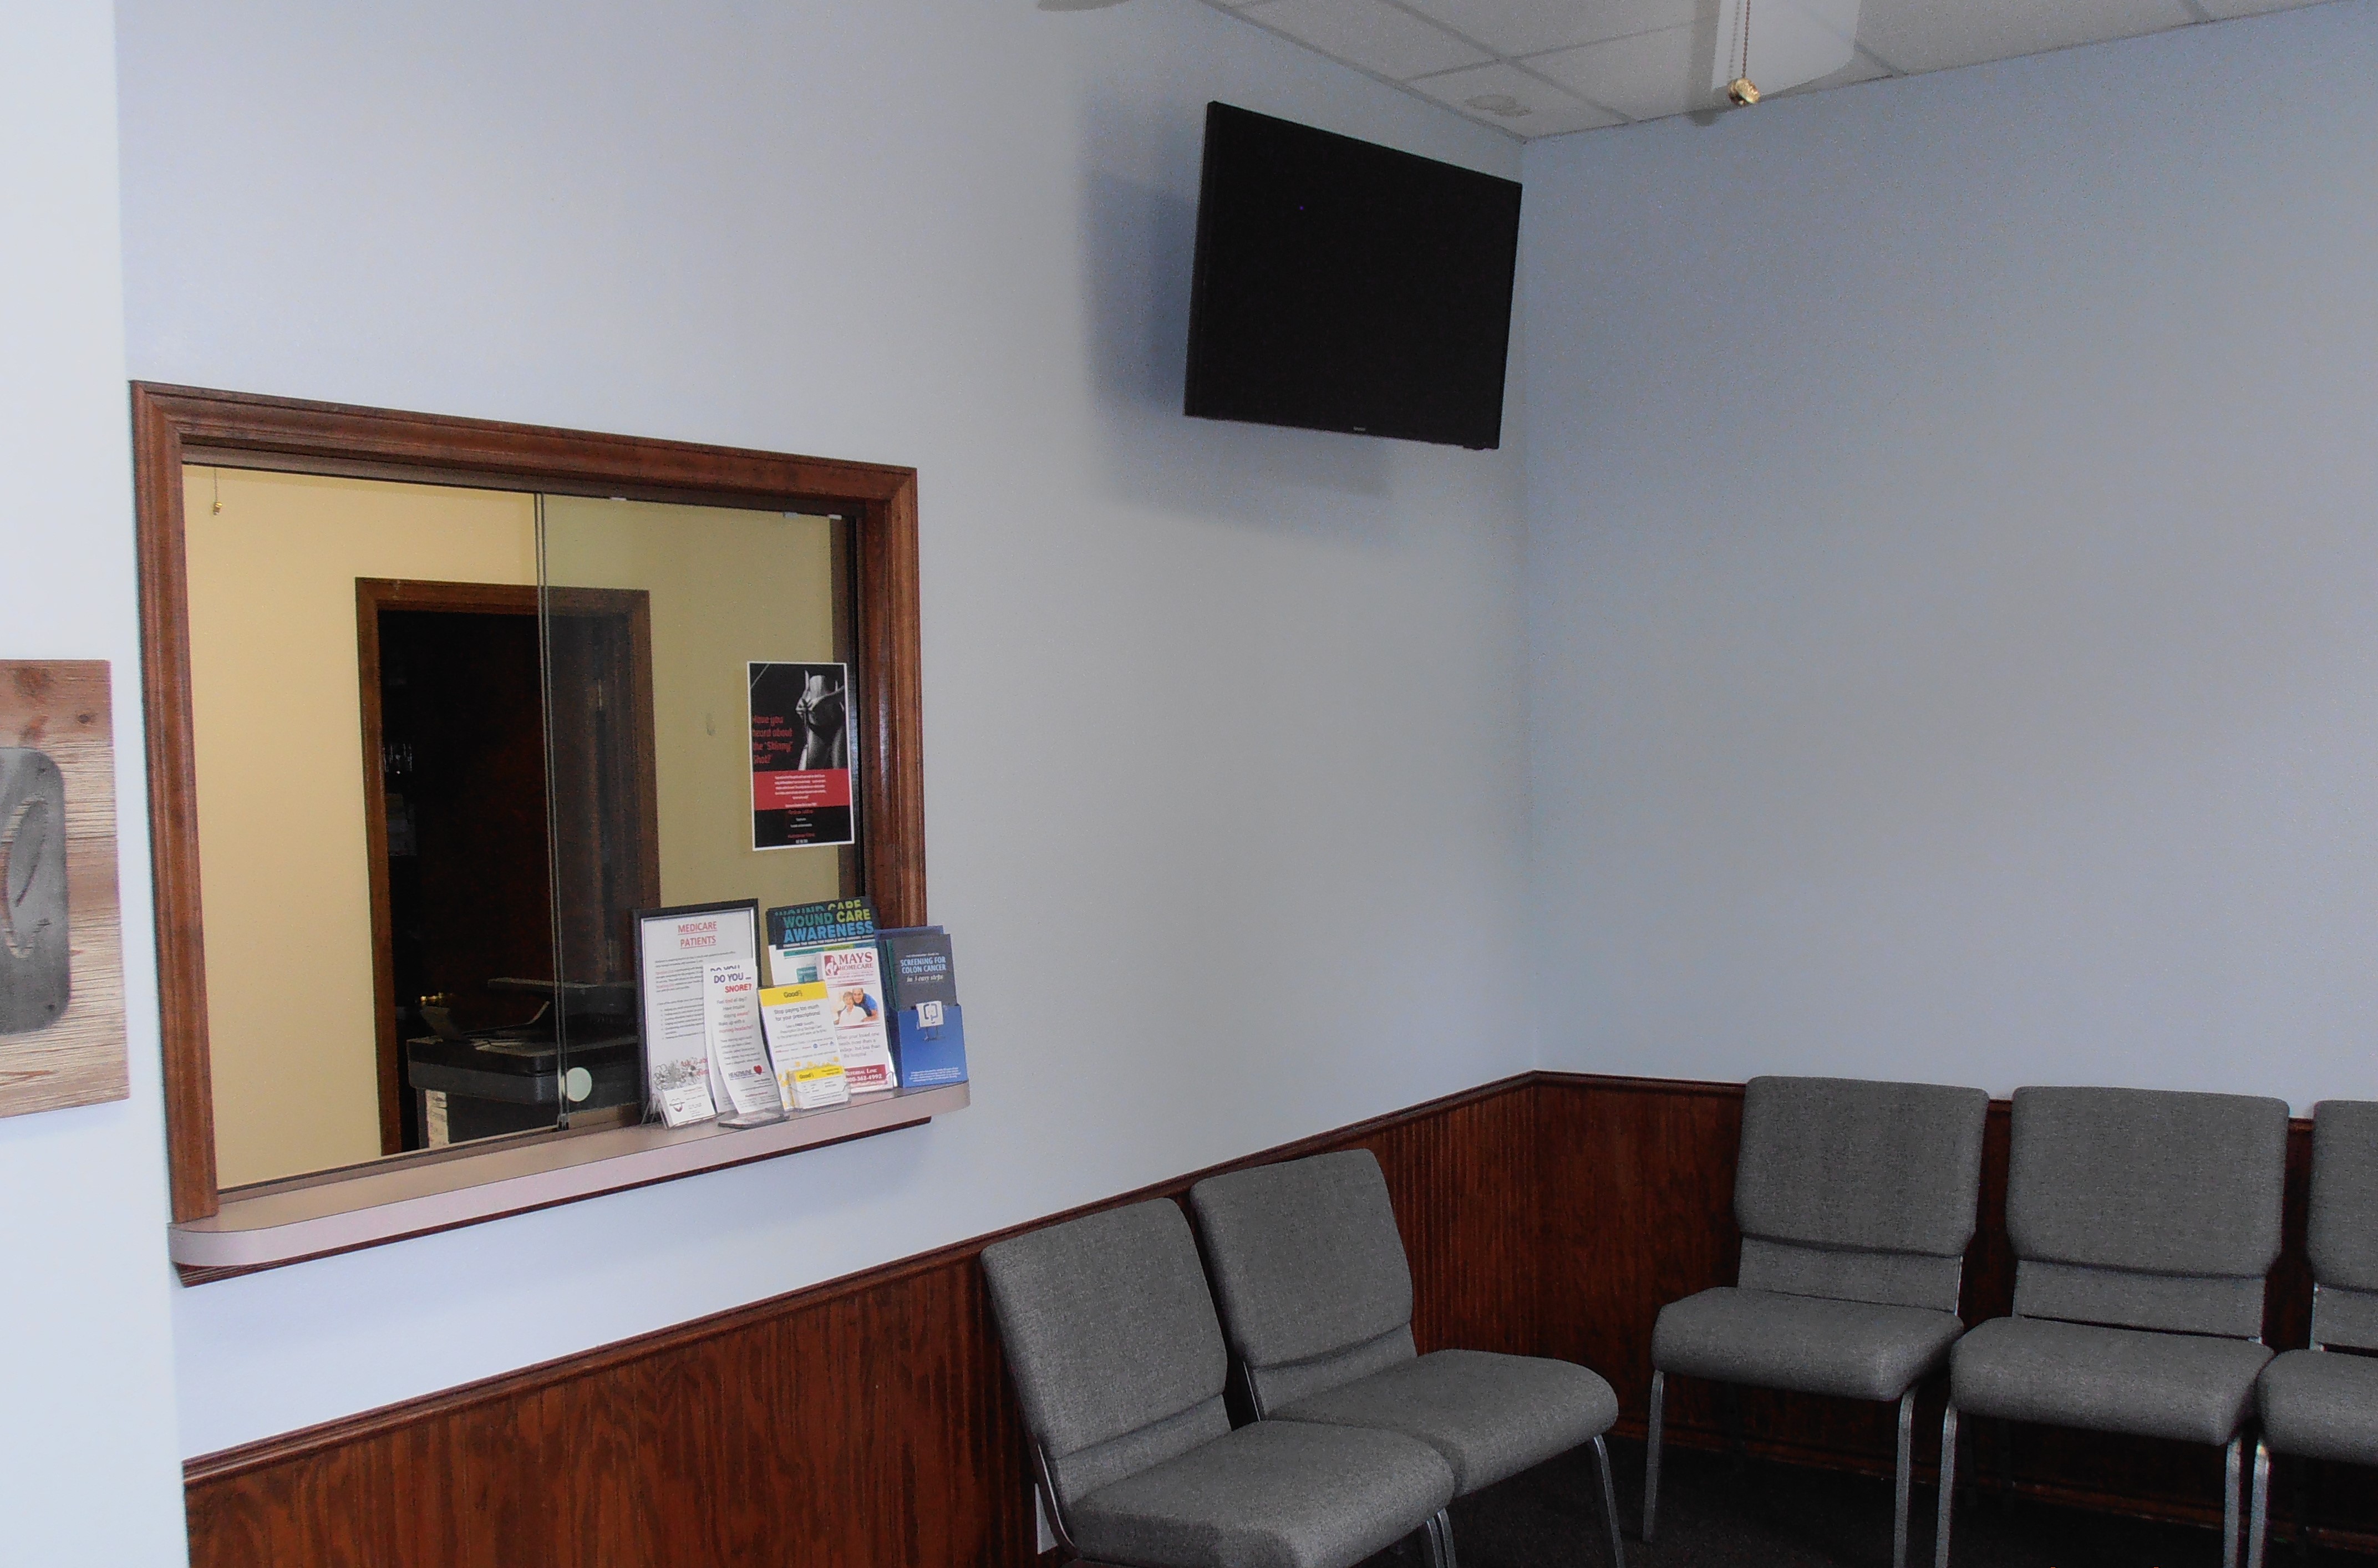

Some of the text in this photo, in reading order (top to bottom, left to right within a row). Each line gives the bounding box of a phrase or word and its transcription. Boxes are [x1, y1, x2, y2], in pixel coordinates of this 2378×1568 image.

[783, 909, 871, 928] WOUND CARE
[678, 921, 717, 934] MEDICARE
[784, 921, 874, 943] AWARENESS
[680, 935, 717, 948] PATIENTS
[839, 951, 872, 965] MAYS
[900, 957, 933, 966] SCREENING
[923, 964, 946, 972] CANCER
[714, 975, 725, 984] DO
[727, 973, 744, 982] YOU
[725, 983, 752, 993] SNORE?
